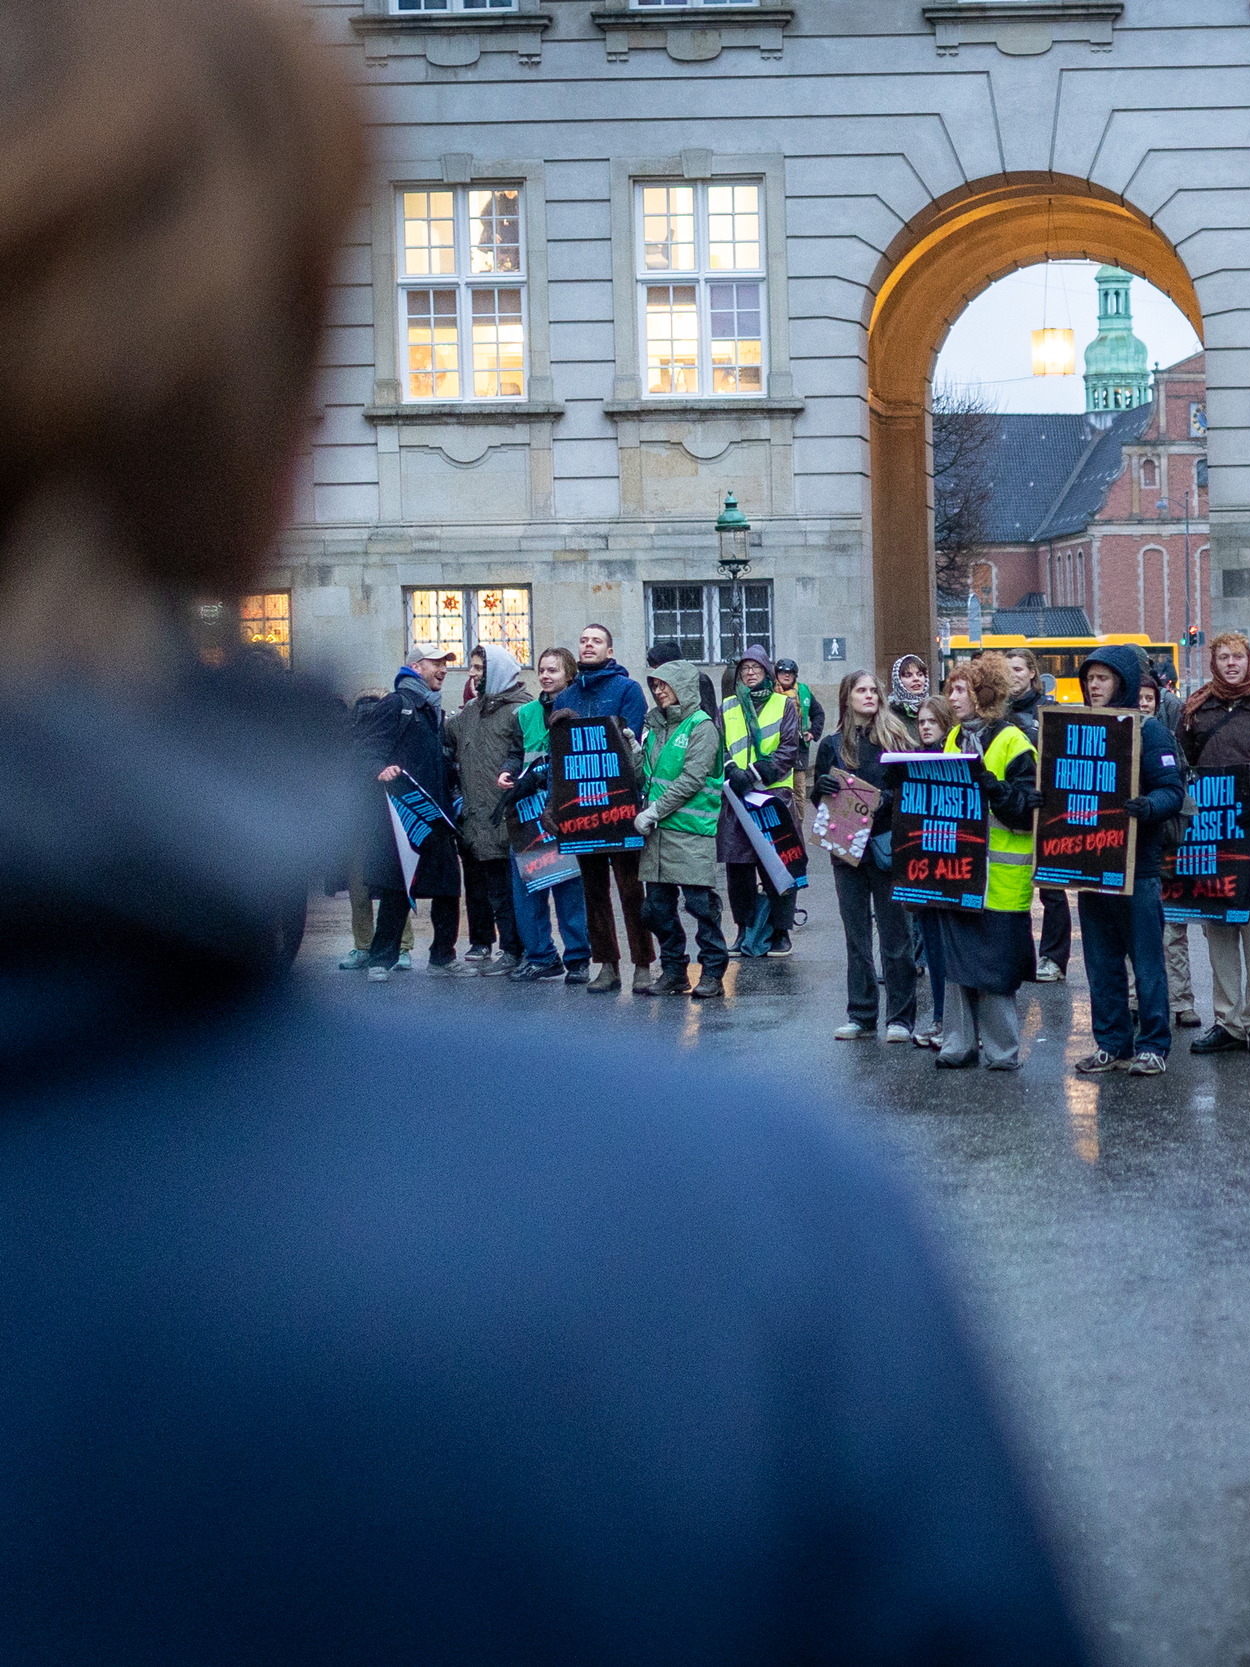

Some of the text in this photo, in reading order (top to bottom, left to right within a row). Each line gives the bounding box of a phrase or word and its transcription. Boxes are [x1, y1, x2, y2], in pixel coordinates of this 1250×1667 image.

[571, 725, 607, 752] EN TRYG
[1067, 724, 1107, 757] EN TRYG
[564, 753, 601, 780] FREMTID
[601, 752, 620, 778] FOR
[906, 760, 972, 784] KLIMALOVEN
[1055, 757, 1117, 793] FREMTID FOR
[578, 781, 610, 806] ELITEN
[900, 781, 982, 820] SKAL PASSE PÅ
[559, 813, 600, 834] VORES
[760, 805, 782, 829] FOR
[1067, 793, 1099, 826] ELITEN
[408, 819, 433, 847] FOR
[922, 819, 957, 854] ELITEN
[1043, 829, 1125, 857] VORES BØRN
[907, 856, 974, 881] OS ALLE
[1175, 844, 1218, 876] ELITEN
[1192, 874, 1238, 898] ALLE
